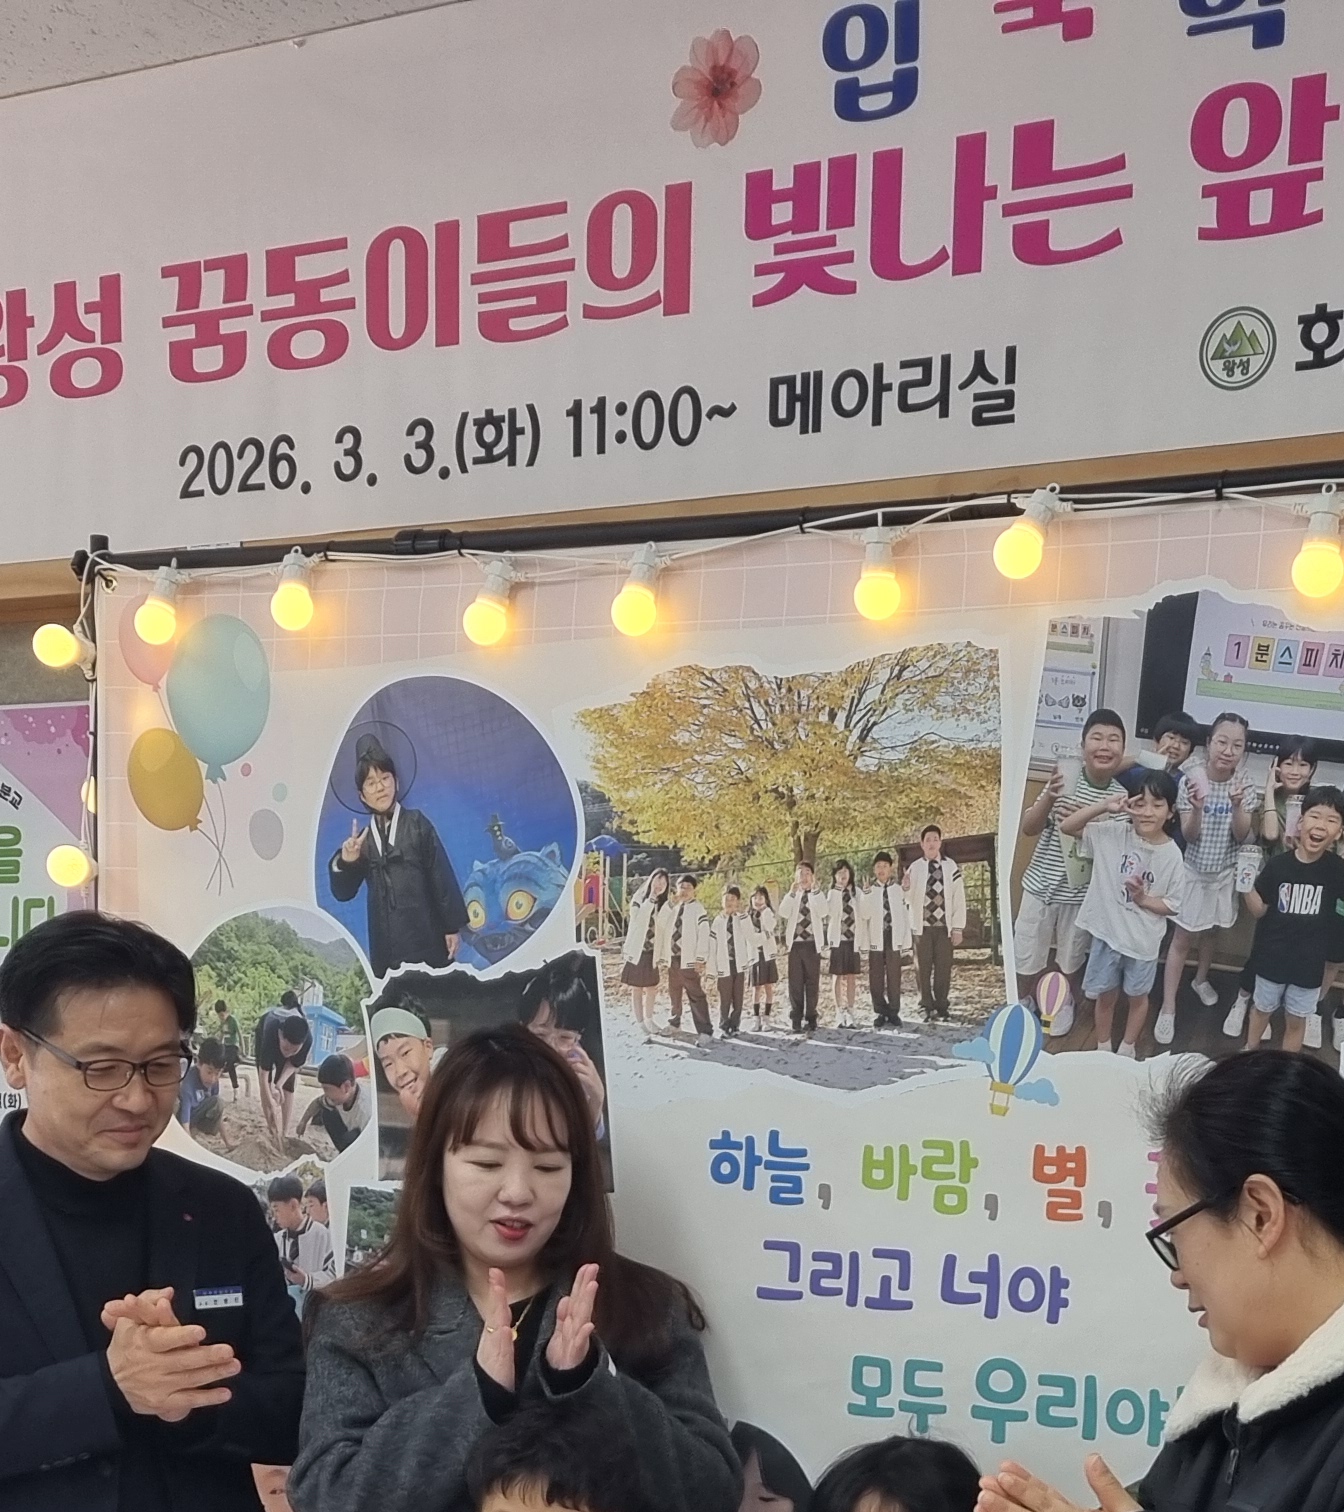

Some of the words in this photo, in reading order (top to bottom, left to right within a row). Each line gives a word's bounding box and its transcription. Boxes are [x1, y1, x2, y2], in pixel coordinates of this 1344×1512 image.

[161, 181, 698, 385] 꿈동이들의
[743, 119, 1134, 309] 빛나는
[1222, 358, 1250, 378] 왕성
[178, 433, 312, 500] 2026.
[334, 425, 378, 487] 3.
[565, 385, 738, 458] 11:00~
[768, 345, 1017, 435] 메아리실
[1289, 883, 1324, 915] NBA
[709, 1130, 832, 1210] 하늘,
[861, 1139, 999, 1222] 바람,
[1032, 1143, 1113, 1229] 별,
[756, 1239, 914, 1311] 그리고
[940, 1253, 1070, 1325] 너야
[847, 1355, 948, 1433] 모두
[971, 1358, 1185, 1448] 우리야
